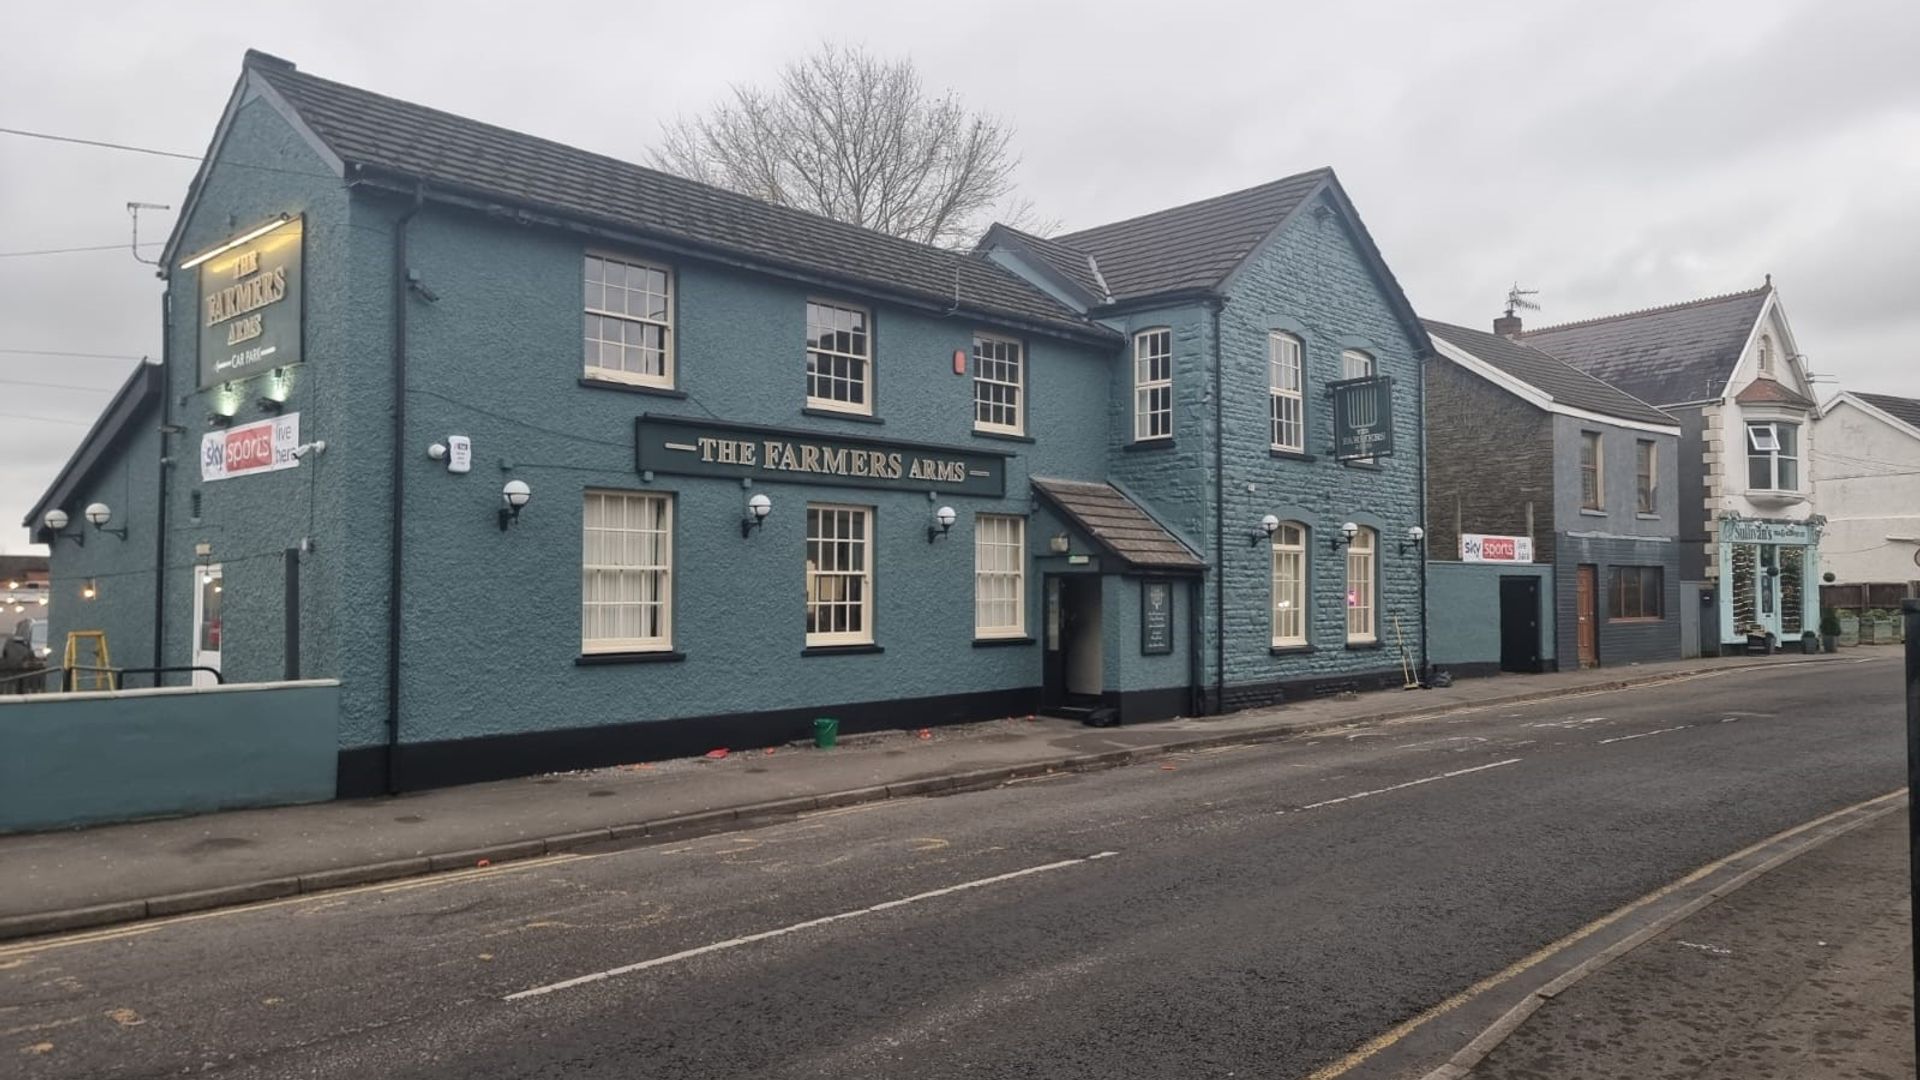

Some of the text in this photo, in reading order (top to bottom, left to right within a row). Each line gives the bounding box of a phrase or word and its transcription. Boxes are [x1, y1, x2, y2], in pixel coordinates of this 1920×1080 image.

[233, 250, 259, 279] THE
[206, 266, 286, 327] FARMERS
[227, 314, 262, 345] ARMS
[231, 346, 261, 369] CAR PARK
[276, 423, 292, 441] live
[205, 434, 270, 470] sky sports
[698, 437, 966, 483] THE FARMERS ARMS
[1465, 540, 1513, 558] sky sports
